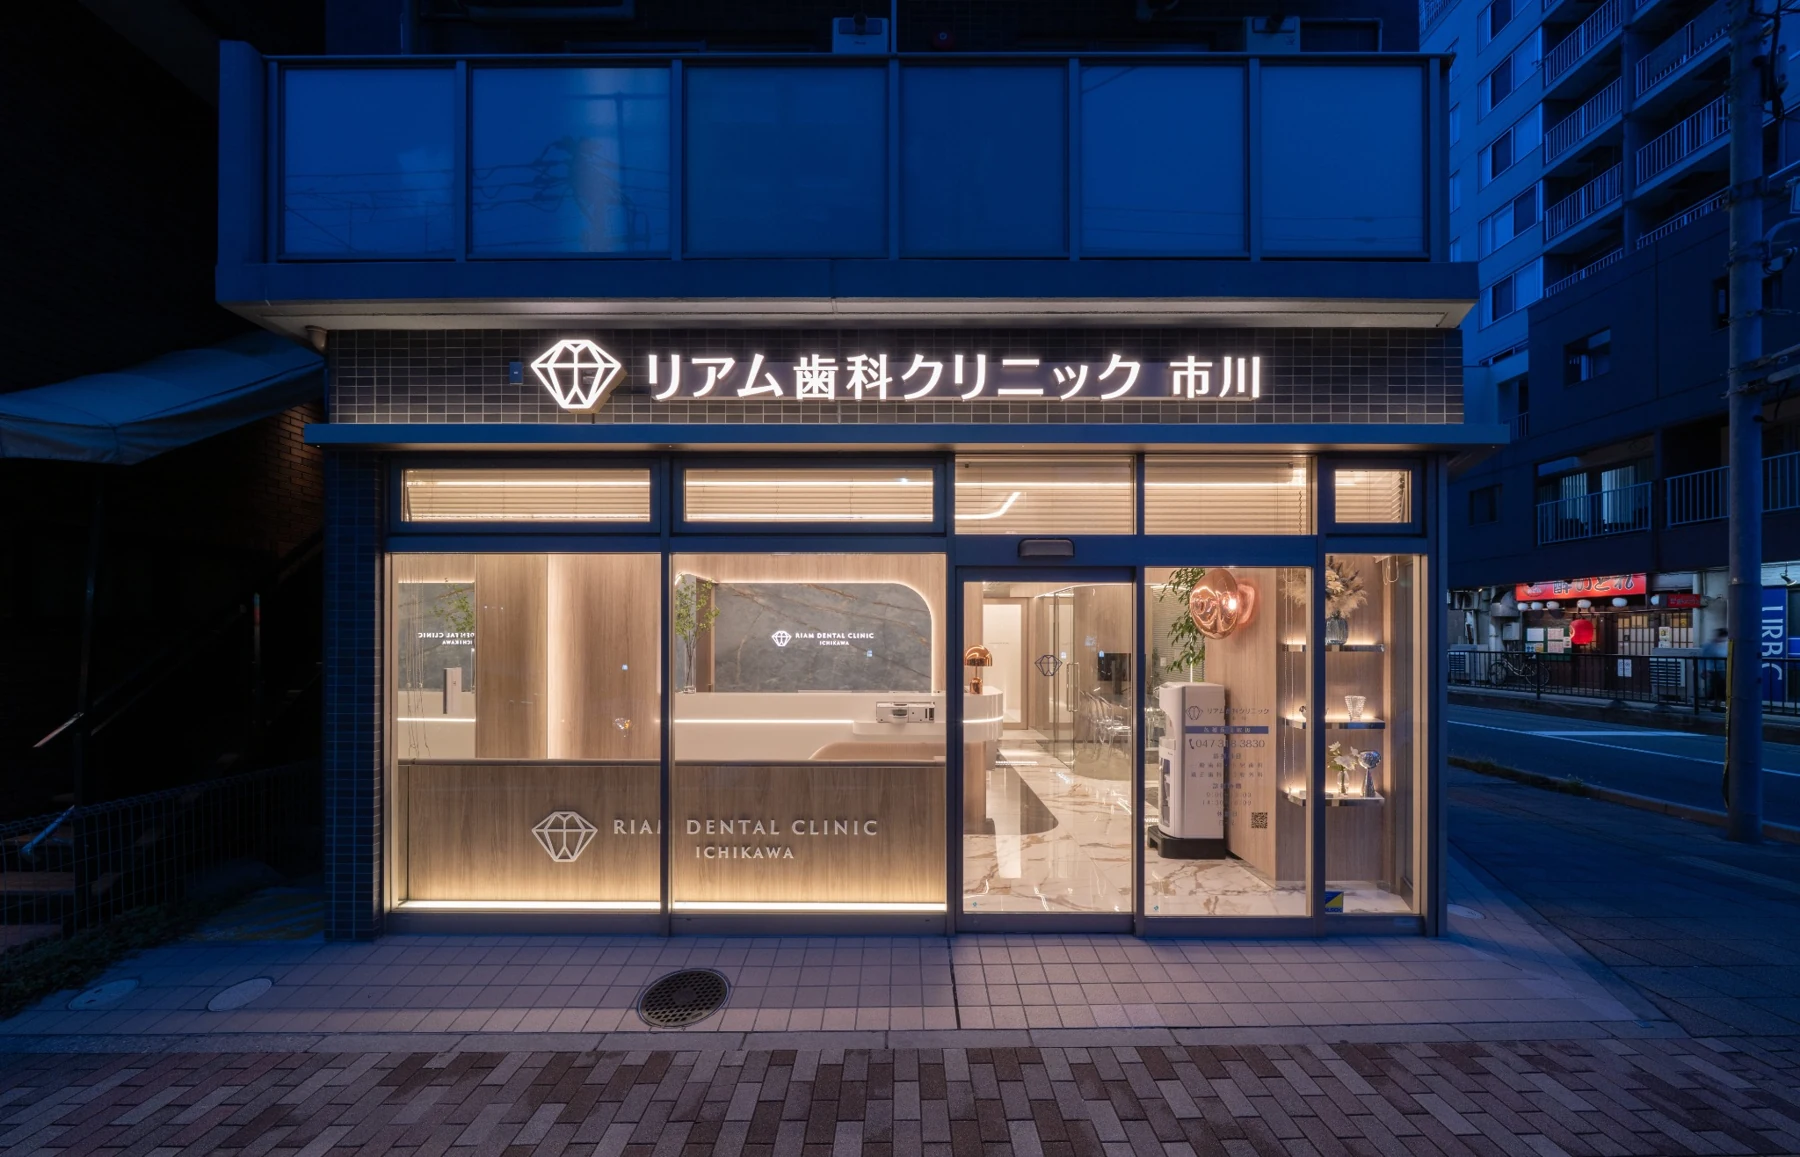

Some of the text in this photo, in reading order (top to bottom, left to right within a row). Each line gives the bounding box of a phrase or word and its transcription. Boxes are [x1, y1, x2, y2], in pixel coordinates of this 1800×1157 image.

[648, 353, 1260, 401] リアム歯科クリニック 市川
[1239, 739, 1266, 748] 3830
[613, 819, 878, 836] RIA DENTAL CLINIC
[695, 846, 794, 859] ICHIKAWA
